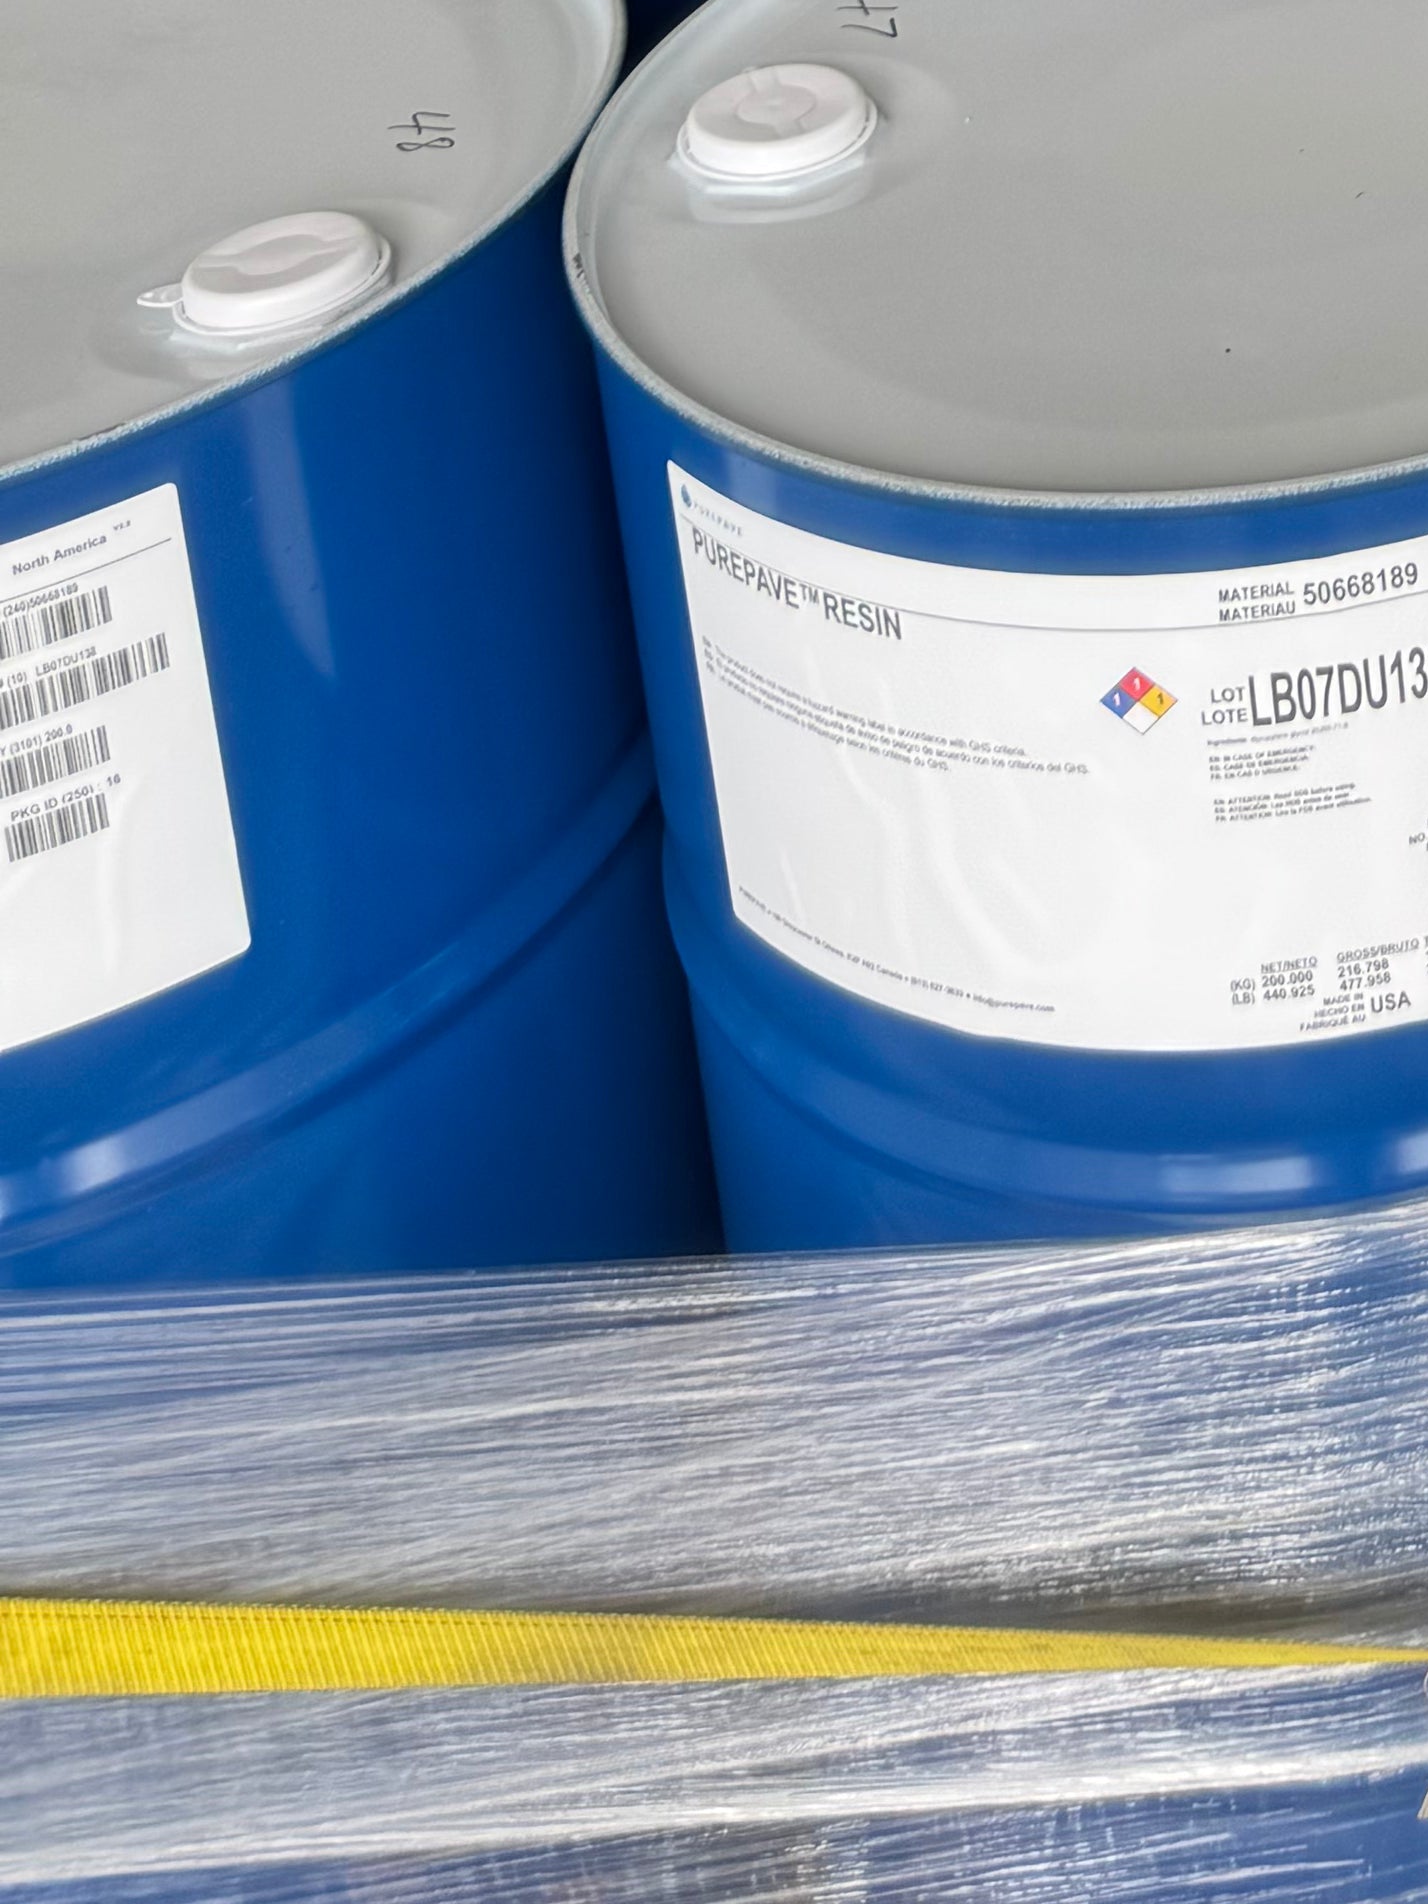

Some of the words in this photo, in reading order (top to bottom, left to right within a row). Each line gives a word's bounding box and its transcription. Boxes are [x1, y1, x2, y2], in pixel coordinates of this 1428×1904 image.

[12, 554, 49, 575] North
[54, 535, 107, 562] America
[1218, 582, 1295, 603] MATERIAL
[1303, 562, 1418, 605] 50668189
[823, 592, 902, 640] RESIN
[1219, 601, 1296, 622] MATERIAU
[1210, 687, 1246, 704] LOT
[1201, 707, 1248, 726] LOTE
[10, 804, 41, 822] PKG
[44, 798, 58, 811] ID
[1230, 978, 1255, 992] (KG)
[1261, 970, 1313, 988] 200.000
[1337, 958, 1390, 978] 216.798
[1232, 993, 1255, 1005] (LB)
[1263, 985, 1315, 1001] 440.925
[1339, 972, 1391, 991] 477.958
[1323, 994, 1351, 1006] MADE
[1370, 991, 1412, 1014] USA
